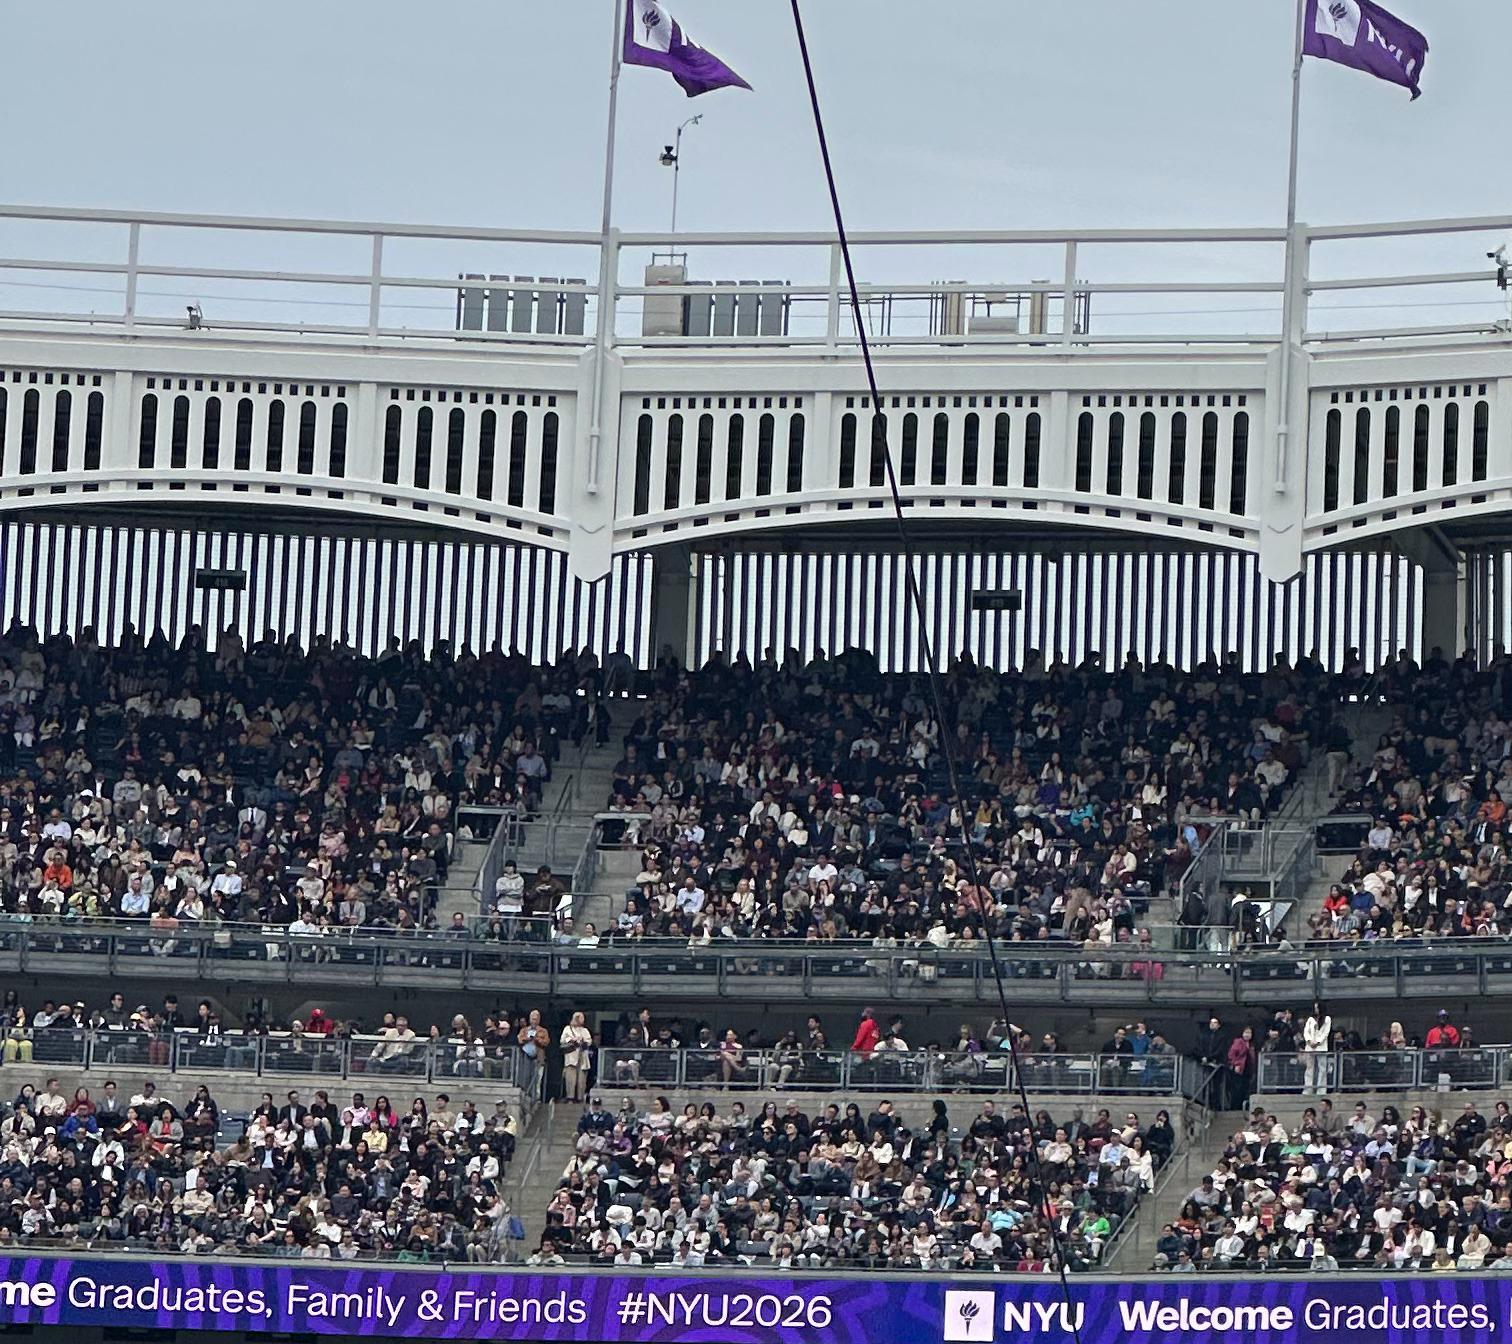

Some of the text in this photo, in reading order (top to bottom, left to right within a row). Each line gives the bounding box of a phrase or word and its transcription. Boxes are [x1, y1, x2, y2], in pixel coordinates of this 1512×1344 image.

[68, 1277, 272, 1318] Graduates,
[288, 1284, 406, 1327] Family
[417, 1289, 444, 1321] &
[454, 1290, 586, 1323] Friends
[617, 1292, 832, 1328] #NYU2026
[1004, 1301, 1085, 1333] NYU
[1119, 1298, 1293, 1331] Welcome
[1304, 1296, 1495, 1332] Graduates,
